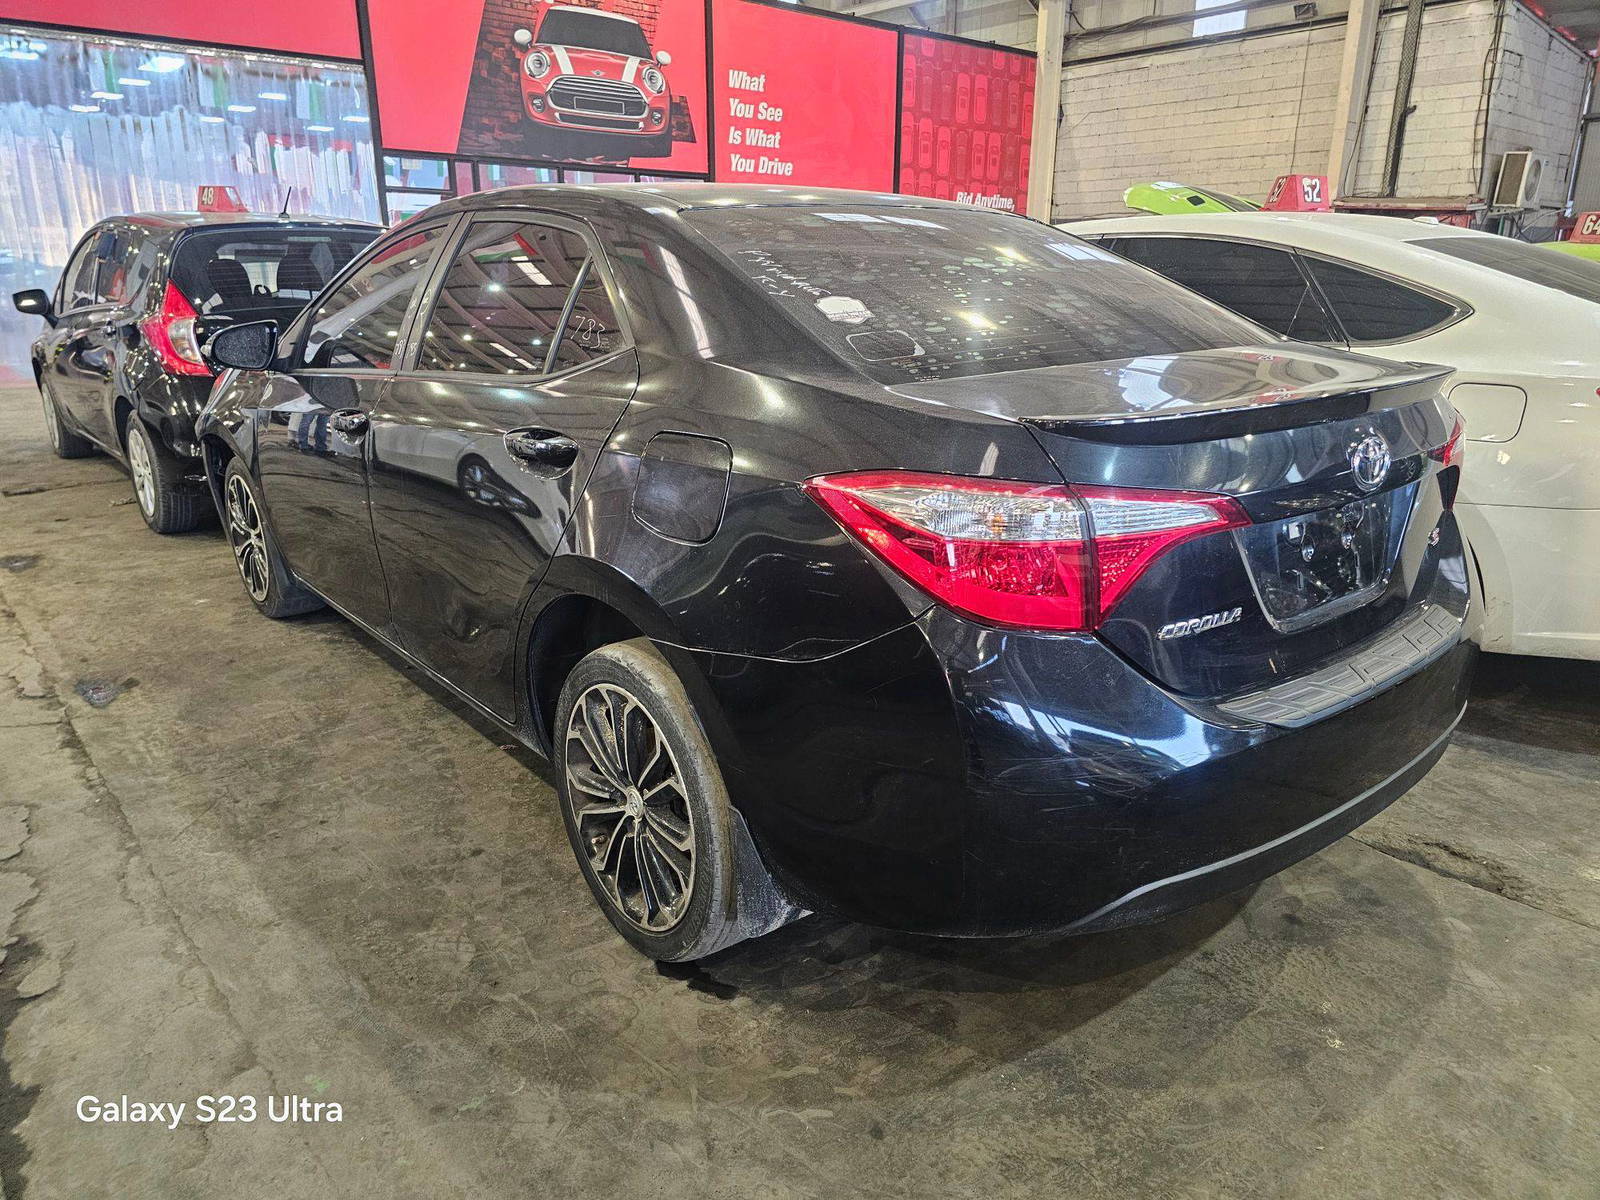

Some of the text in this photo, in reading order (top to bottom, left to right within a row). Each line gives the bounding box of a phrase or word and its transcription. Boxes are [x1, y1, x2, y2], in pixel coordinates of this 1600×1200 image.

[728, 69, 765, 92] What
[729, 97, 783, 122] You See
[728, 126, 781, 149] Is What
[730, 153, 793, 176] You Drive
[202, 186, 214, 205] 48
[956, 191, 974, 205] Bid
[1302, 177, 1321, 202] 52
[1157, 607, 1242, 640] COROLLA
